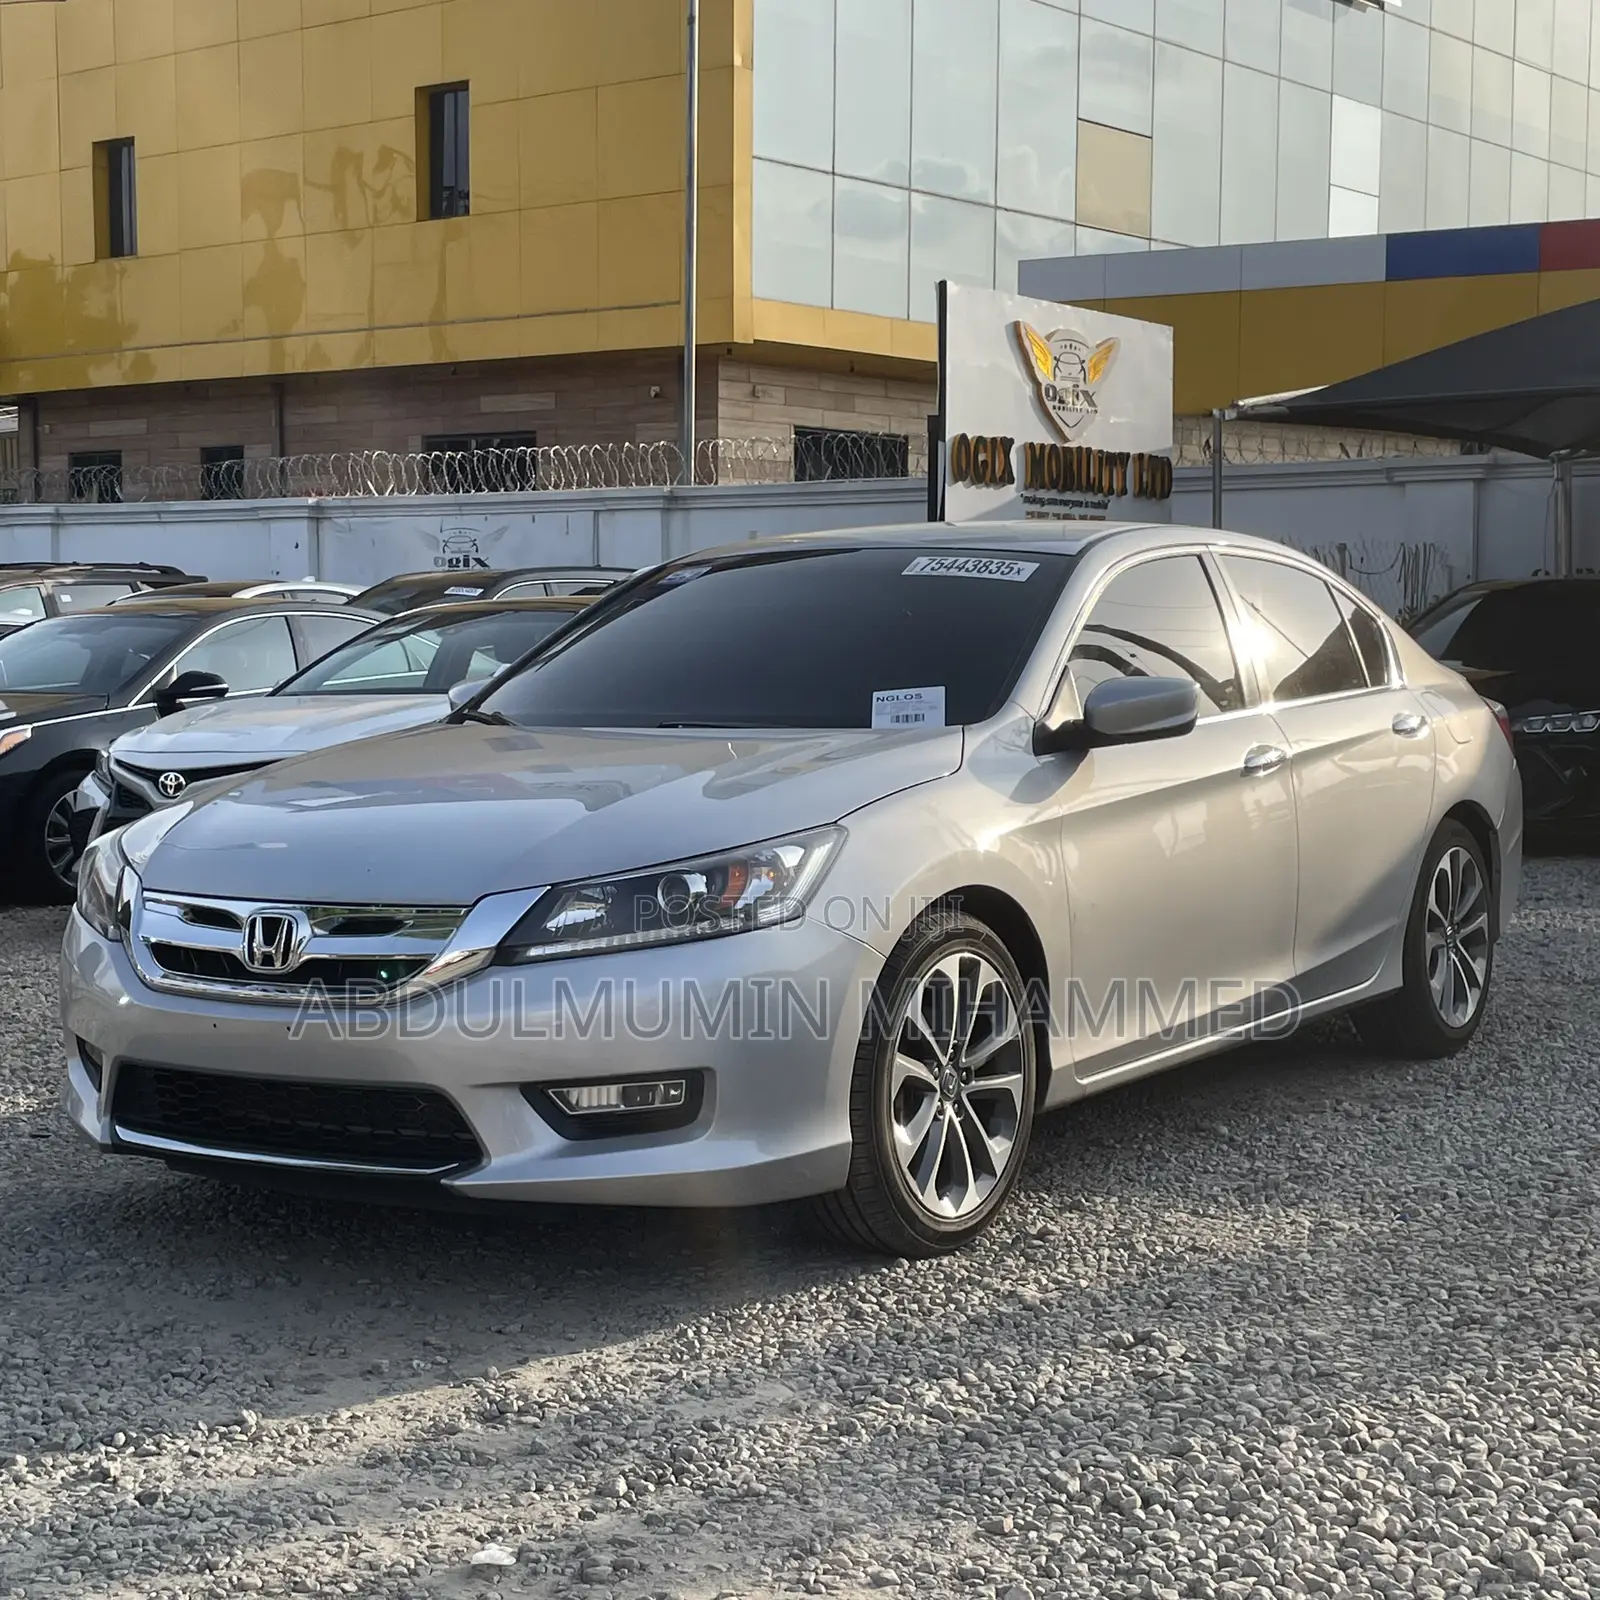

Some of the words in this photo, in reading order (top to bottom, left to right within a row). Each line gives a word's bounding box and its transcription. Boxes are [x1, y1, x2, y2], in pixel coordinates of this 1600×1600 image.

[951, 432, 1015, 485] OGIX
[1023, 441, 1131, 498] MOBILITY
[1132, 452, 1173, 500] LTD
